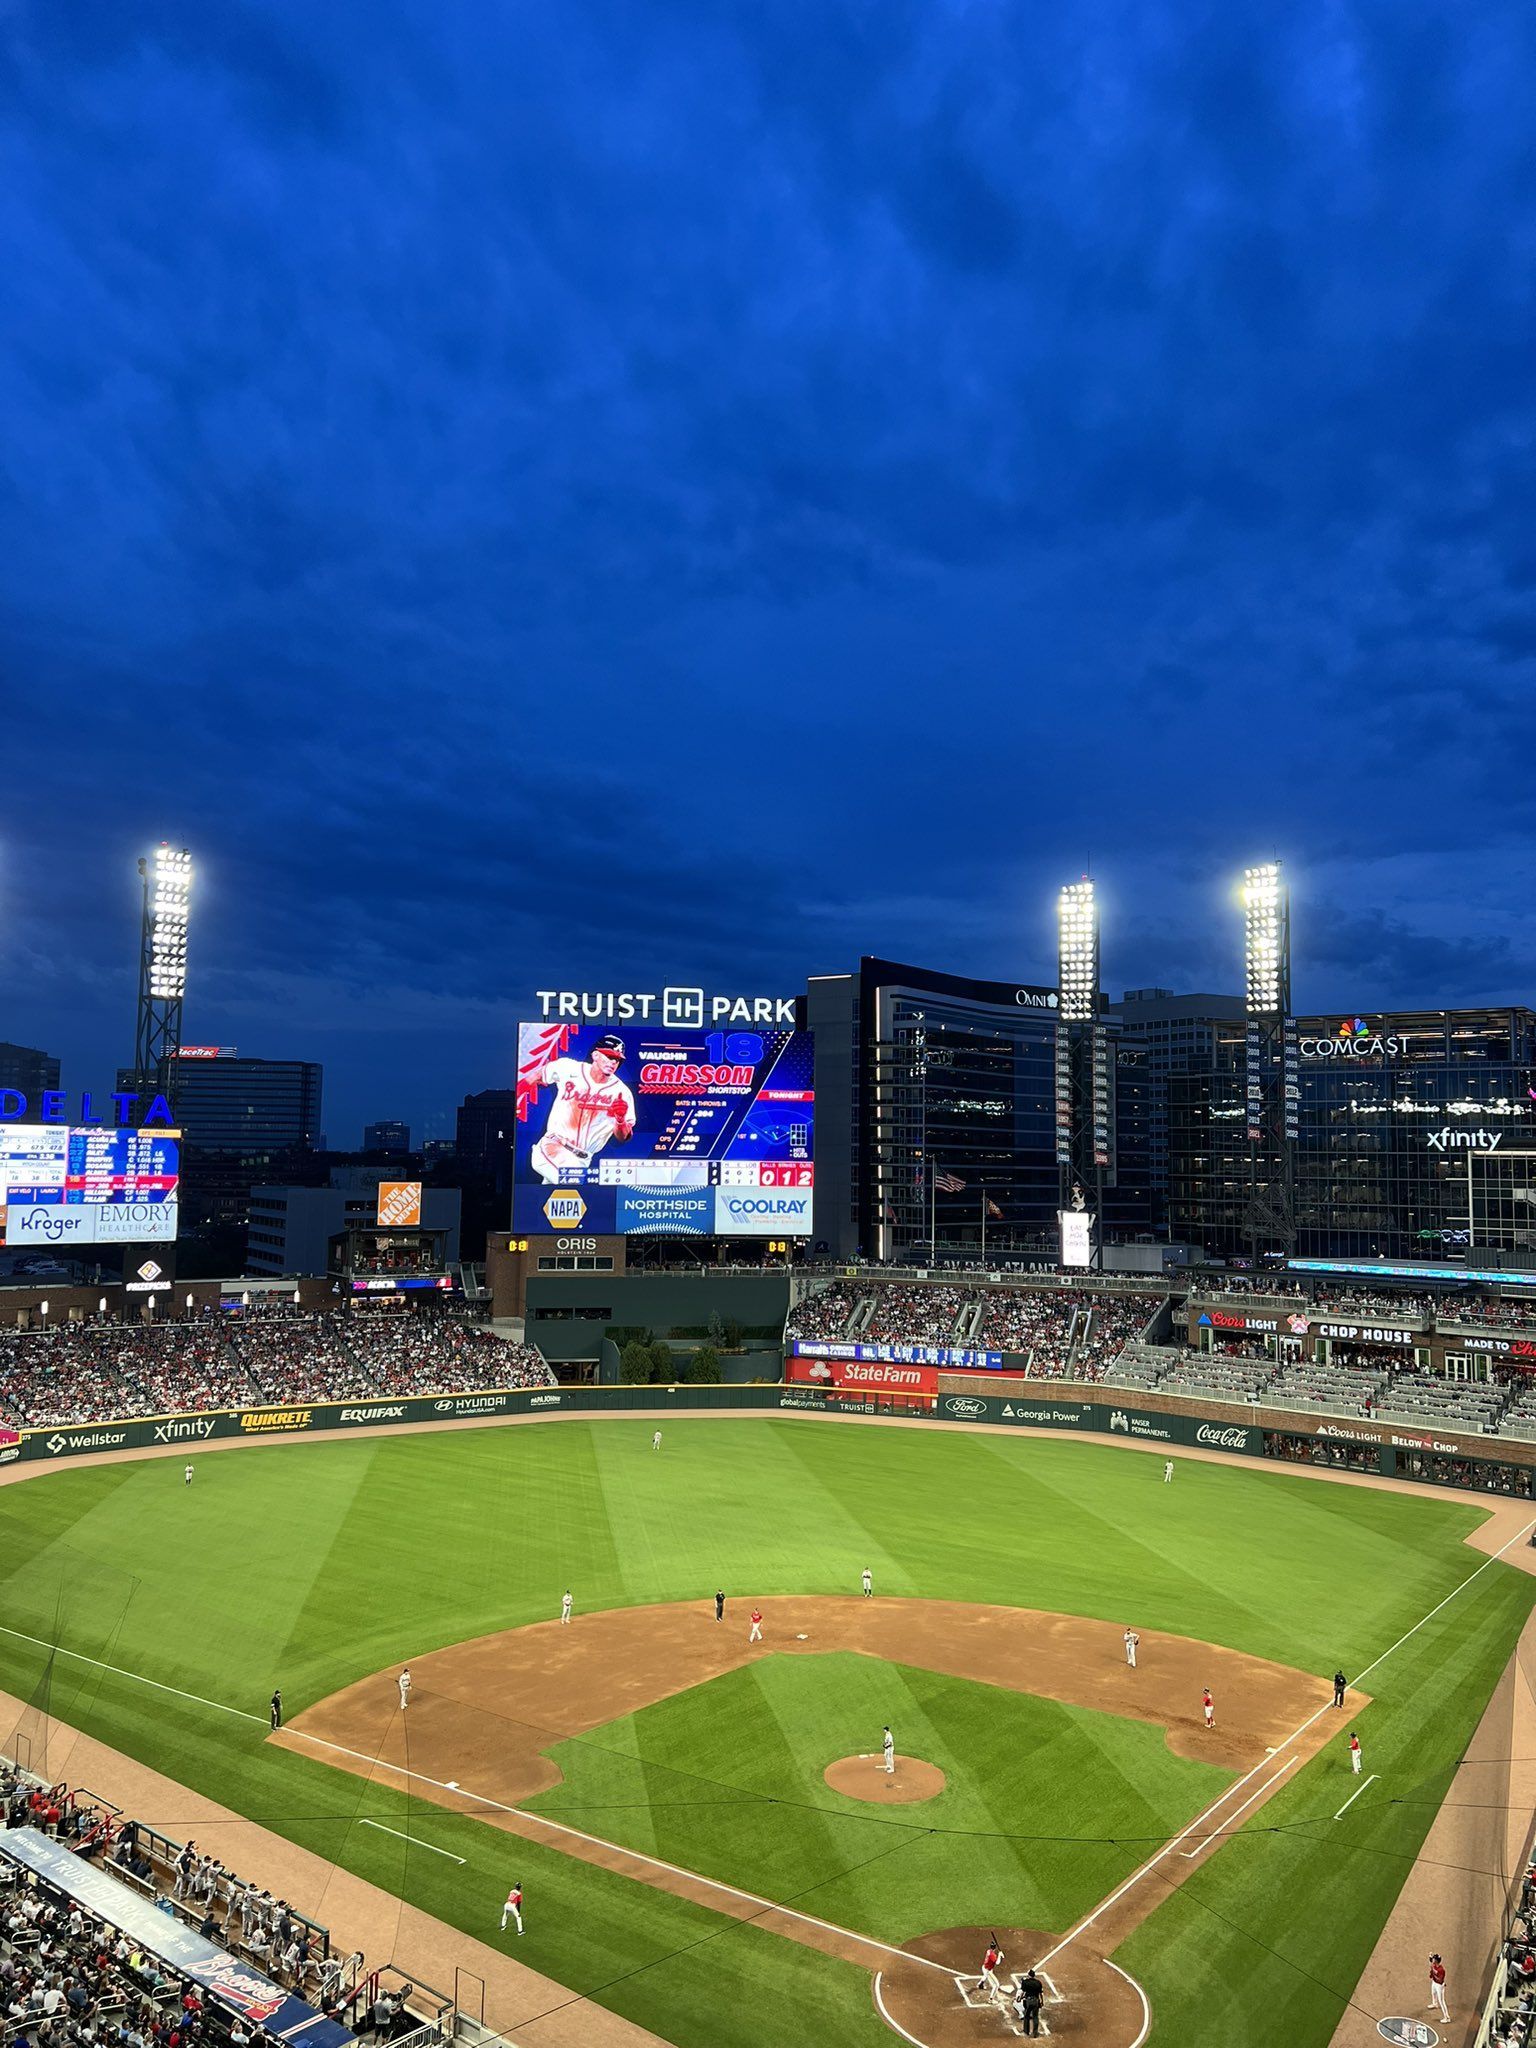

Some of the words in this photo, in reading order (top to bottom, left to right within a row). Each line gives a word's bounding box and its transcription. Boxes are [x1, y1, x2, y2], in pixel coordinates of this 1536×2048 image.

[536, 991, 656, 1018] TRUIST
[712, 996, 796, 1023] PARK
[705, 1032, 764, 1065] 18
[1300, 1036, 1411, 1057] COMCAST
[638, 1051, 687, 1061] VAUGHN
[640, 1064, 755, 1086] GRISSOM
[707, 1086, 751, 1095] SHORTSTOP
[768, 1091, 805, 1099] TONIGHT
[0, 1088, 175, 1124] DELTA
[1249, 1129, 1260, 1138] 2021
[1426, 1127, 1502, 1151] xfinity
[761, 1170, 775, 1185] 0
[782, 1171, 792, 1185] 1
[798, 1171, 812, 1185] 2
[384, 1187, 401, 1204] THE
[379, 1184, 421, 1224] HOME
[394, 1197, 421, 1224] DEPOT
[551, 1201, 580, 1217] NAPA
[624, 1199, 707, 1210] NORTHSIDE
[729, 1199, 808, 1214] COOLRAY
[100, 1205, 175, 1222] EMORY
[639, 1211, 692, 1219] HOSPITAL
[21, 1208, 82, 1240] Kroger
[556, 1238, 597, 1250] ORIS
[1211, 1312, 1245, 1328] Coors
[1246, 1318, 1278, 1331] LIGHT
[1319, 1324, 1358, 1339] CHOP
[1363, 1328, 1413, 1344] HOUSE
[1464, 1339, 1493, 1349] MADE
[1495, 1341, 1510, 1351] TO
[456, 1396, 507, 1409] HYUNDAI
[840, 1403, 865, 1411] TRUIST
[953, 1399, 979, 1412] Ford
[240, 1411, 312, 1428] QUIKRETE
[340, 1406, 405, 1422] EQUIFAX
[1017, 1408, 1051, 1421] Georgia
[1052, 1411, 1080, 1422] Power
[154, 1417, 216, 1442] xfinity
[1131, 1418, 1151, 1427] KAISER
[1131, 1426, 1169, 1438] PERMANENTE
[1196, 1424, 1250, 1449] Coca-Cola
[1327, 1425, 1355, 1438] Coors
[1356, 1433, 1382, 1443] LIGHT
[69, 1433, 126, 1448] Wellstar
[1392, 1435, 1423, 1448] BELOW
[1433, 1441, 1459, 1453] CHOP
[12, 1834, 46, 1855] WELCOME
[51, 1859, 96, 1893] TRUIST
[109, 1895, 147, 1923] PARK
[175, 1941, 195, 1954] THE
[180, 1954, 286, 2000] Braves
